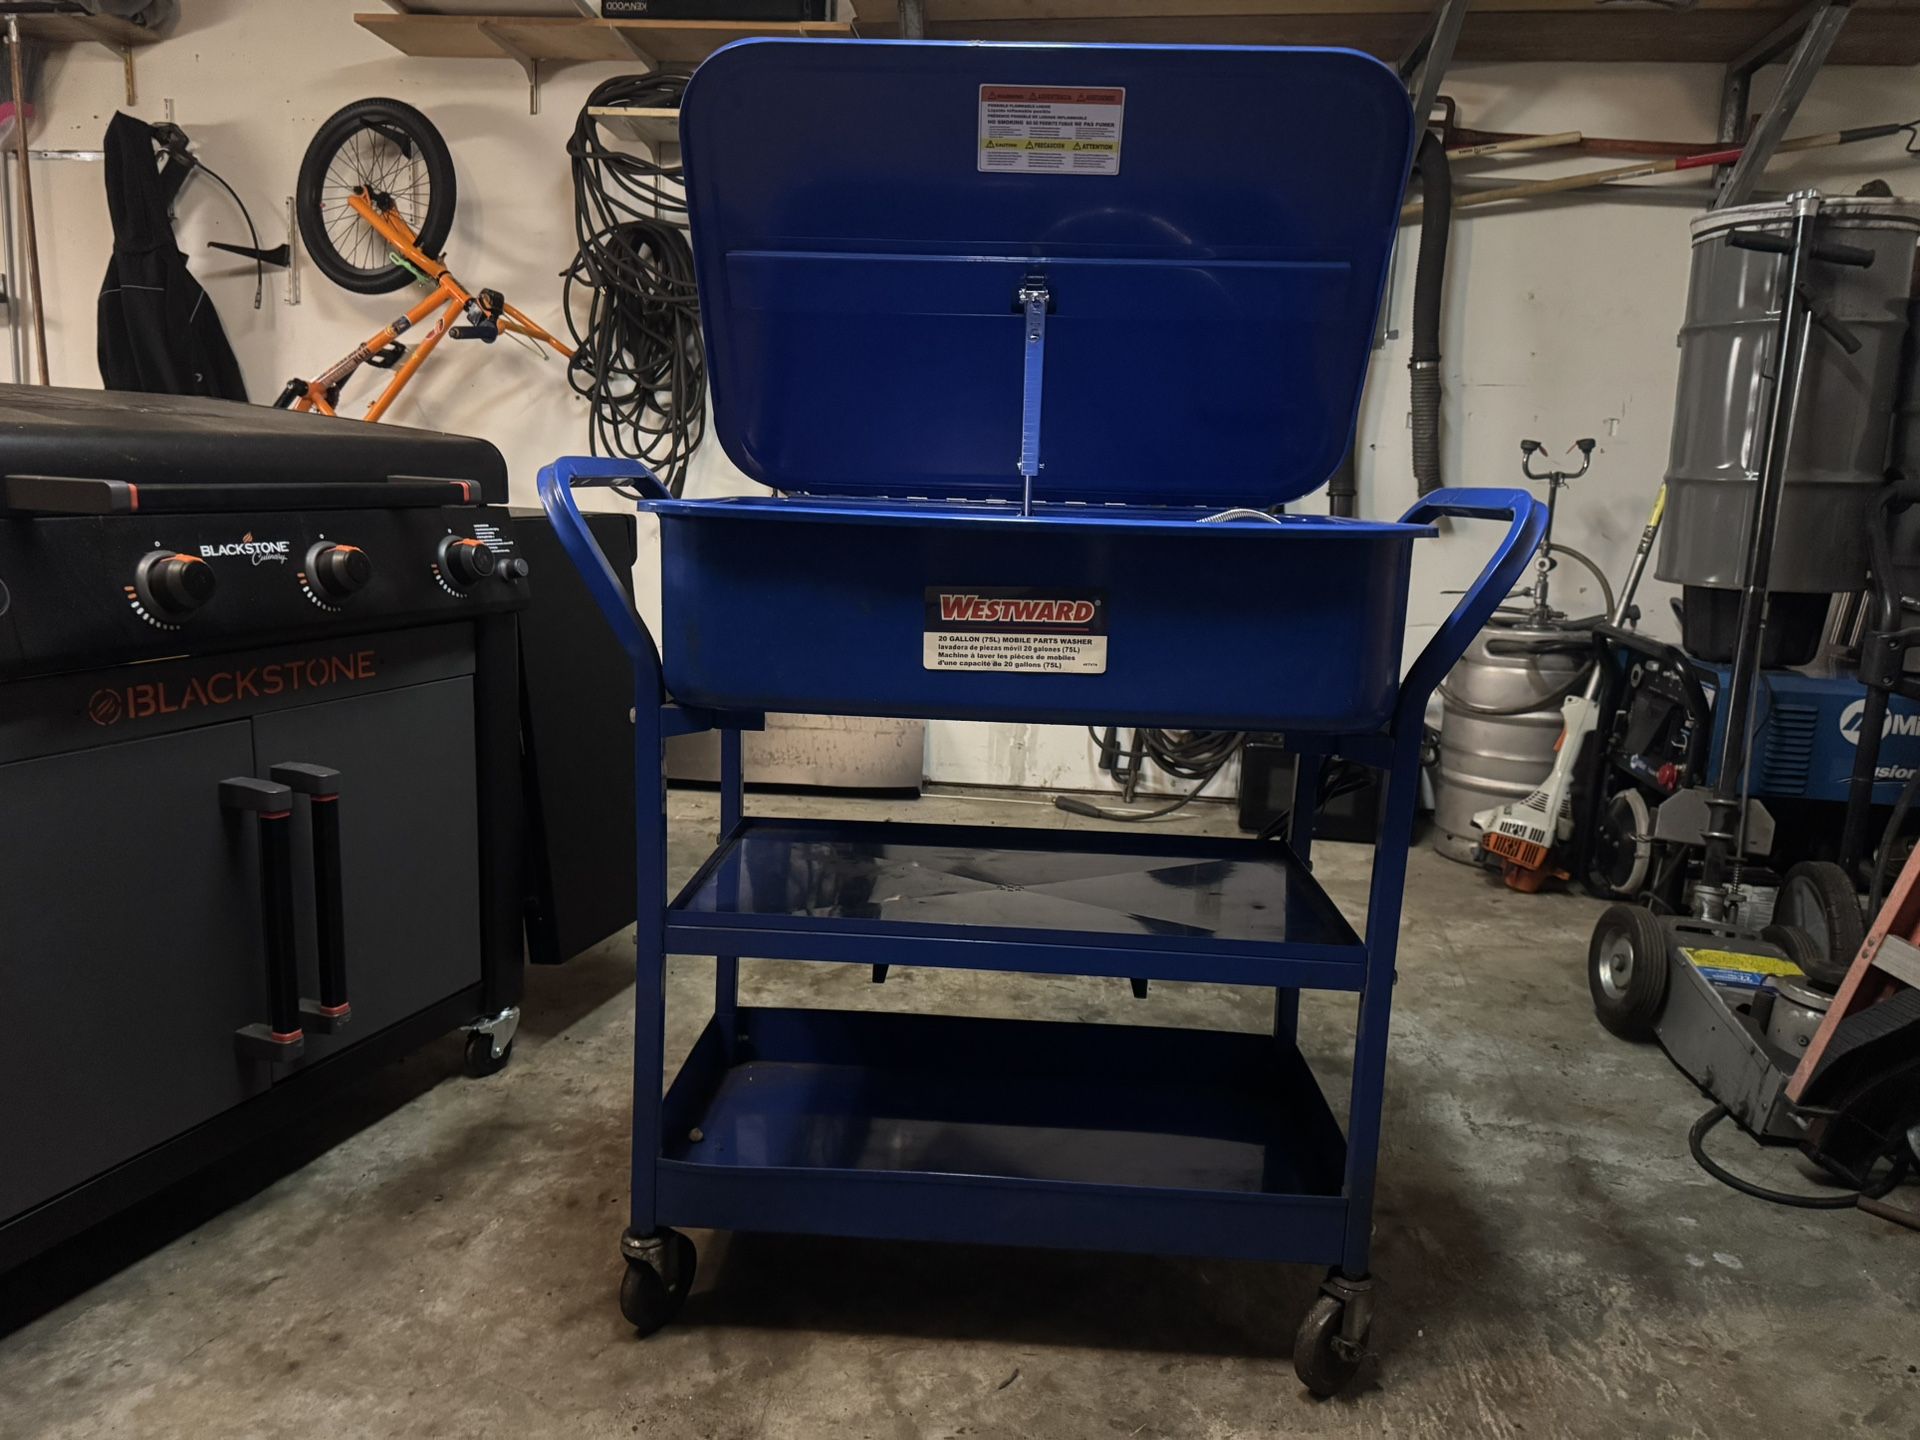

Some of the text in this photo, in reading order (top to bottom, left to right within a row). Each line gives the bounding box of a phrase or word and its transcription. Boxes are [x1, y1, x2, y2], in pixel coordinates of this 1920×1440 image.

[606, 2, 647, 10] KENWOOD
[200, 541, 290, 557] BLACKSTONE
[252, 552, 288, 566] Culinary
[940, 594, 1096, 624] WESTWARD
[1043, 662, 1062, 670] (75L)
[126, 650, 377, 720] BLACKSTONE
